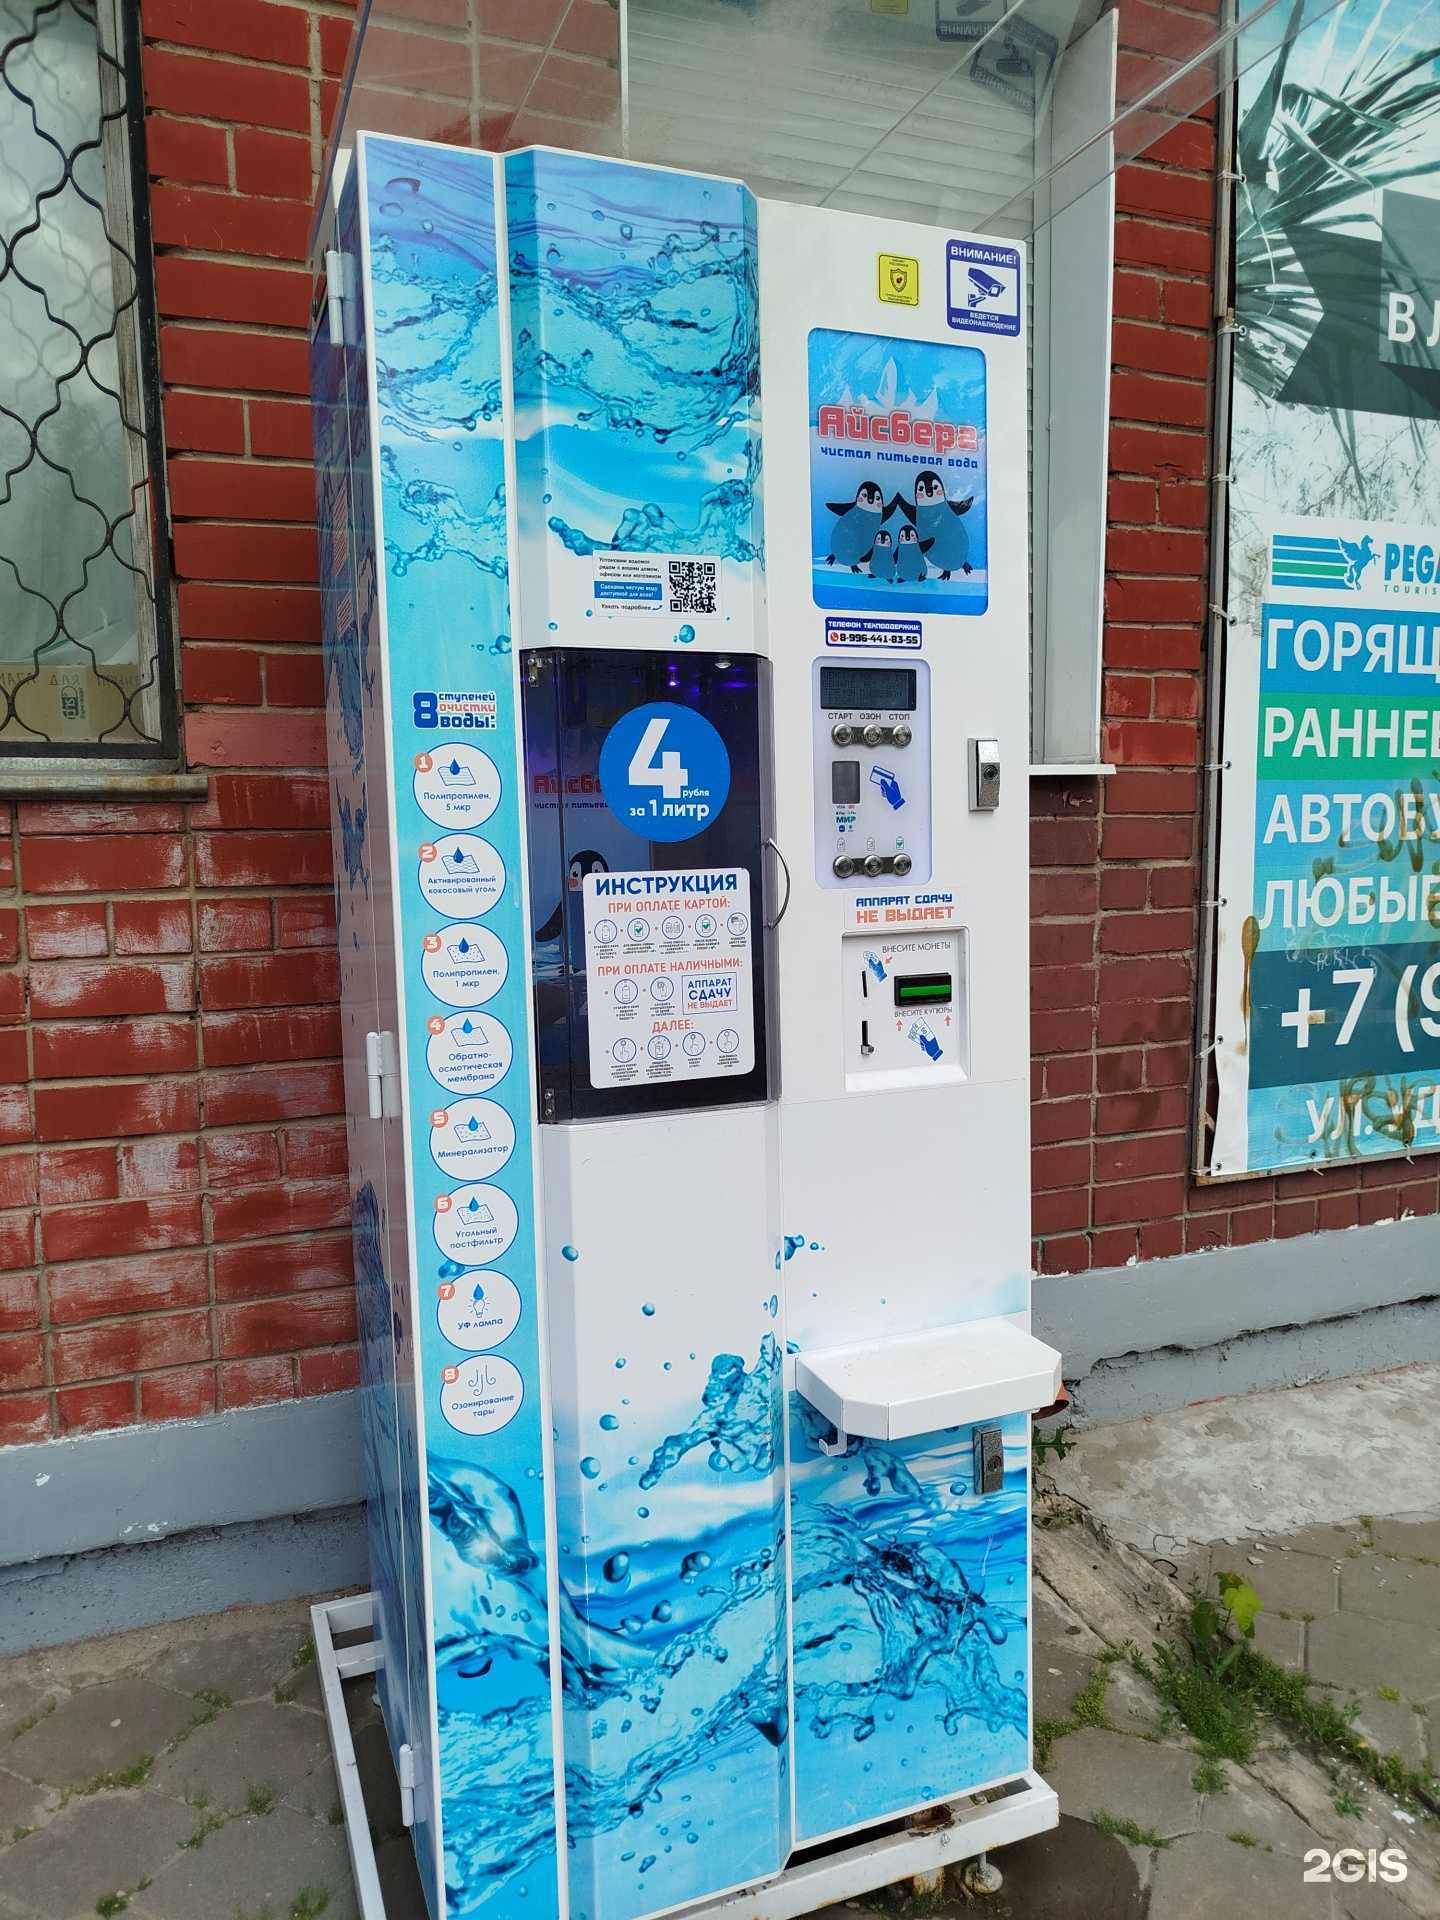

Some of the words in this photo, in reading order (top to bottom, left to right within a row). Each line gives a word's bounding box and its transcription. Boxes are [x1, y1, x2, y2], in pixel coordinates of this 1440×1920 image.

[950, 245, 1017, 265] ВНИМАНИЕ!
[969, 311, 999, 321] ВЕДЕТСЯ
[951, 316, 1017, 331] ВИДЕОНАБЛЮДЕНИЕ
[819, 405, 978, 454] Айсберг
[821, 446, 871, 460] чистая
[877, 451, 943, 466] питьевая
[948, 458, 978, 469] вода
[828, 620, 861, 629] ТЕЛЕФОН
[840, 633, 918, 645] 8-996-441-83-55
[413, 692, 438, 728] 8
[439, 692, 496, 702] ступеней
[440, 703, 496, 712] очистки
[440, 713, 496, 728] воды:
[828, 712, 853, 720] СТАРТ
[419, 756, 429, 770] 1
[628, 718, 688, 798] 4
[424, 792, 492, 801] Полипропилен,
[682, 788, 710, 797] рубля
[446, 803, 451, 811] 5
[453, 803, 471, 812] мкр
[629, 806, 645, 816] за
[649, 799, 658, 816] 1
[662, 802, 710, 821] литр
[422, 843, 434, 858] 2
[428, 875, 496, 885] Активированный
[596, 874, 737, 896] ИНСТРУКЦИЯ
[428, 886, 473, 894] кокосовый
[475, 886, 497, 895] уголь
[608, 902, 631, 913] ПРИ
[636, 900, 680, 912] ОПЛАТЕ
[685, 896, 731, 910] КАРТОЙ:
[856, 896, 910, 907] АППАРАТ
[915, 893, 952, 905] СДАЧУ
[856, 909, 879, 923] НЕ
[885, 906, 954, 921] ВЫДАЕТ
[882, 944, 916, 953] ВНЕСИТЕ
[918, 942, 951, 951] МОНЕТЫ
[433, 968, 500, 978] Полипропилен,
[598, 966, 620, 977] ПРИ
[625, 963, 666, 974] ОПЛАТЕ
[670, 958, 743, 972] НАЛИЧНЫМИ:
[462, 980, 480, 989] мкр
[688, 978, 732, 988] АППАРАТ
[689, 988, 731, 1000] СДАЧУ
[700, 999, 732, 1008] ВЫДАЕТ
[1282, 968, 1376, 1049] +7
[894, 1008, 923, 1017] ВНЕСИТЕ
[923, 1007, 952, 1015] КУПЮРЫ
[431, 1018, 442, 1032] 4
[652, 1019, 695, 1033] ДАЛЕЕ:
[448, 1052, 492, 1062] Обратно-
[438, 1062, 503, 1073] осмотическая
[447, 1073, 495, 1083] мембрана
[433, 1111, 445, 1125] 5
[438, 1146, 509, 1158] Минерализатор
[456, 1227, 498, 1238] Угольный
[450, 1237, 504, 1249] постфильтр
[440, 1284, 452, 1298] 7
[473, 1318, 503, 1328] лампа
[451, 1394, 515, 1411] Озонирование
[472, 1408, 495, 1418] тары
